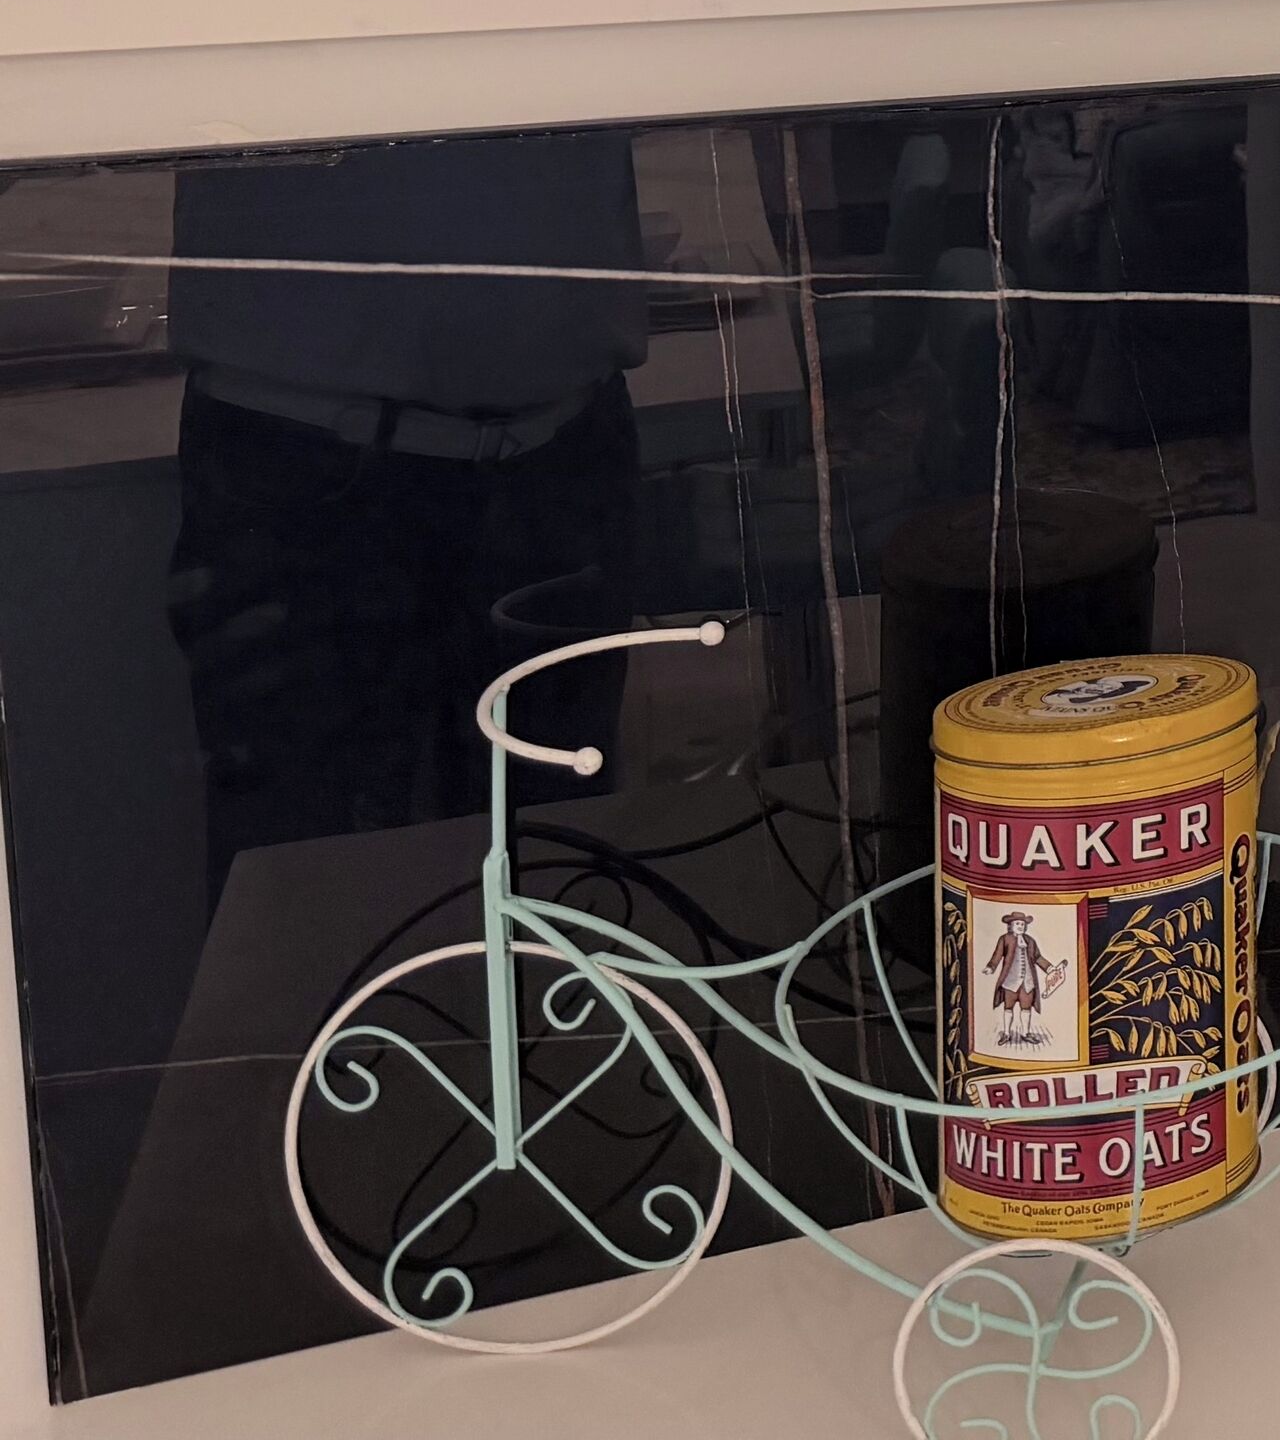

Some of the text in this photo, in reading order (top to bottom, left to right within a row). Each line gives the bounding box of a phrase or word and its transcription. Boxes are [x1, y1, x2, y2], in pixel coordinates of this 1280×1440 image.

[947, 803, 1209, 868] QUAKER
[1229, 833, 1250, 995] Quaker
[985, 1066, 1181, 1108] ROLLED
[953, 1113, 1212, 1182] WHITE OATS
[1001, 1202, 1020, 1213] The
[1022, 1205, 1062, 1217] Quaker
[1064, 1205, 1090, 1217] Oats
